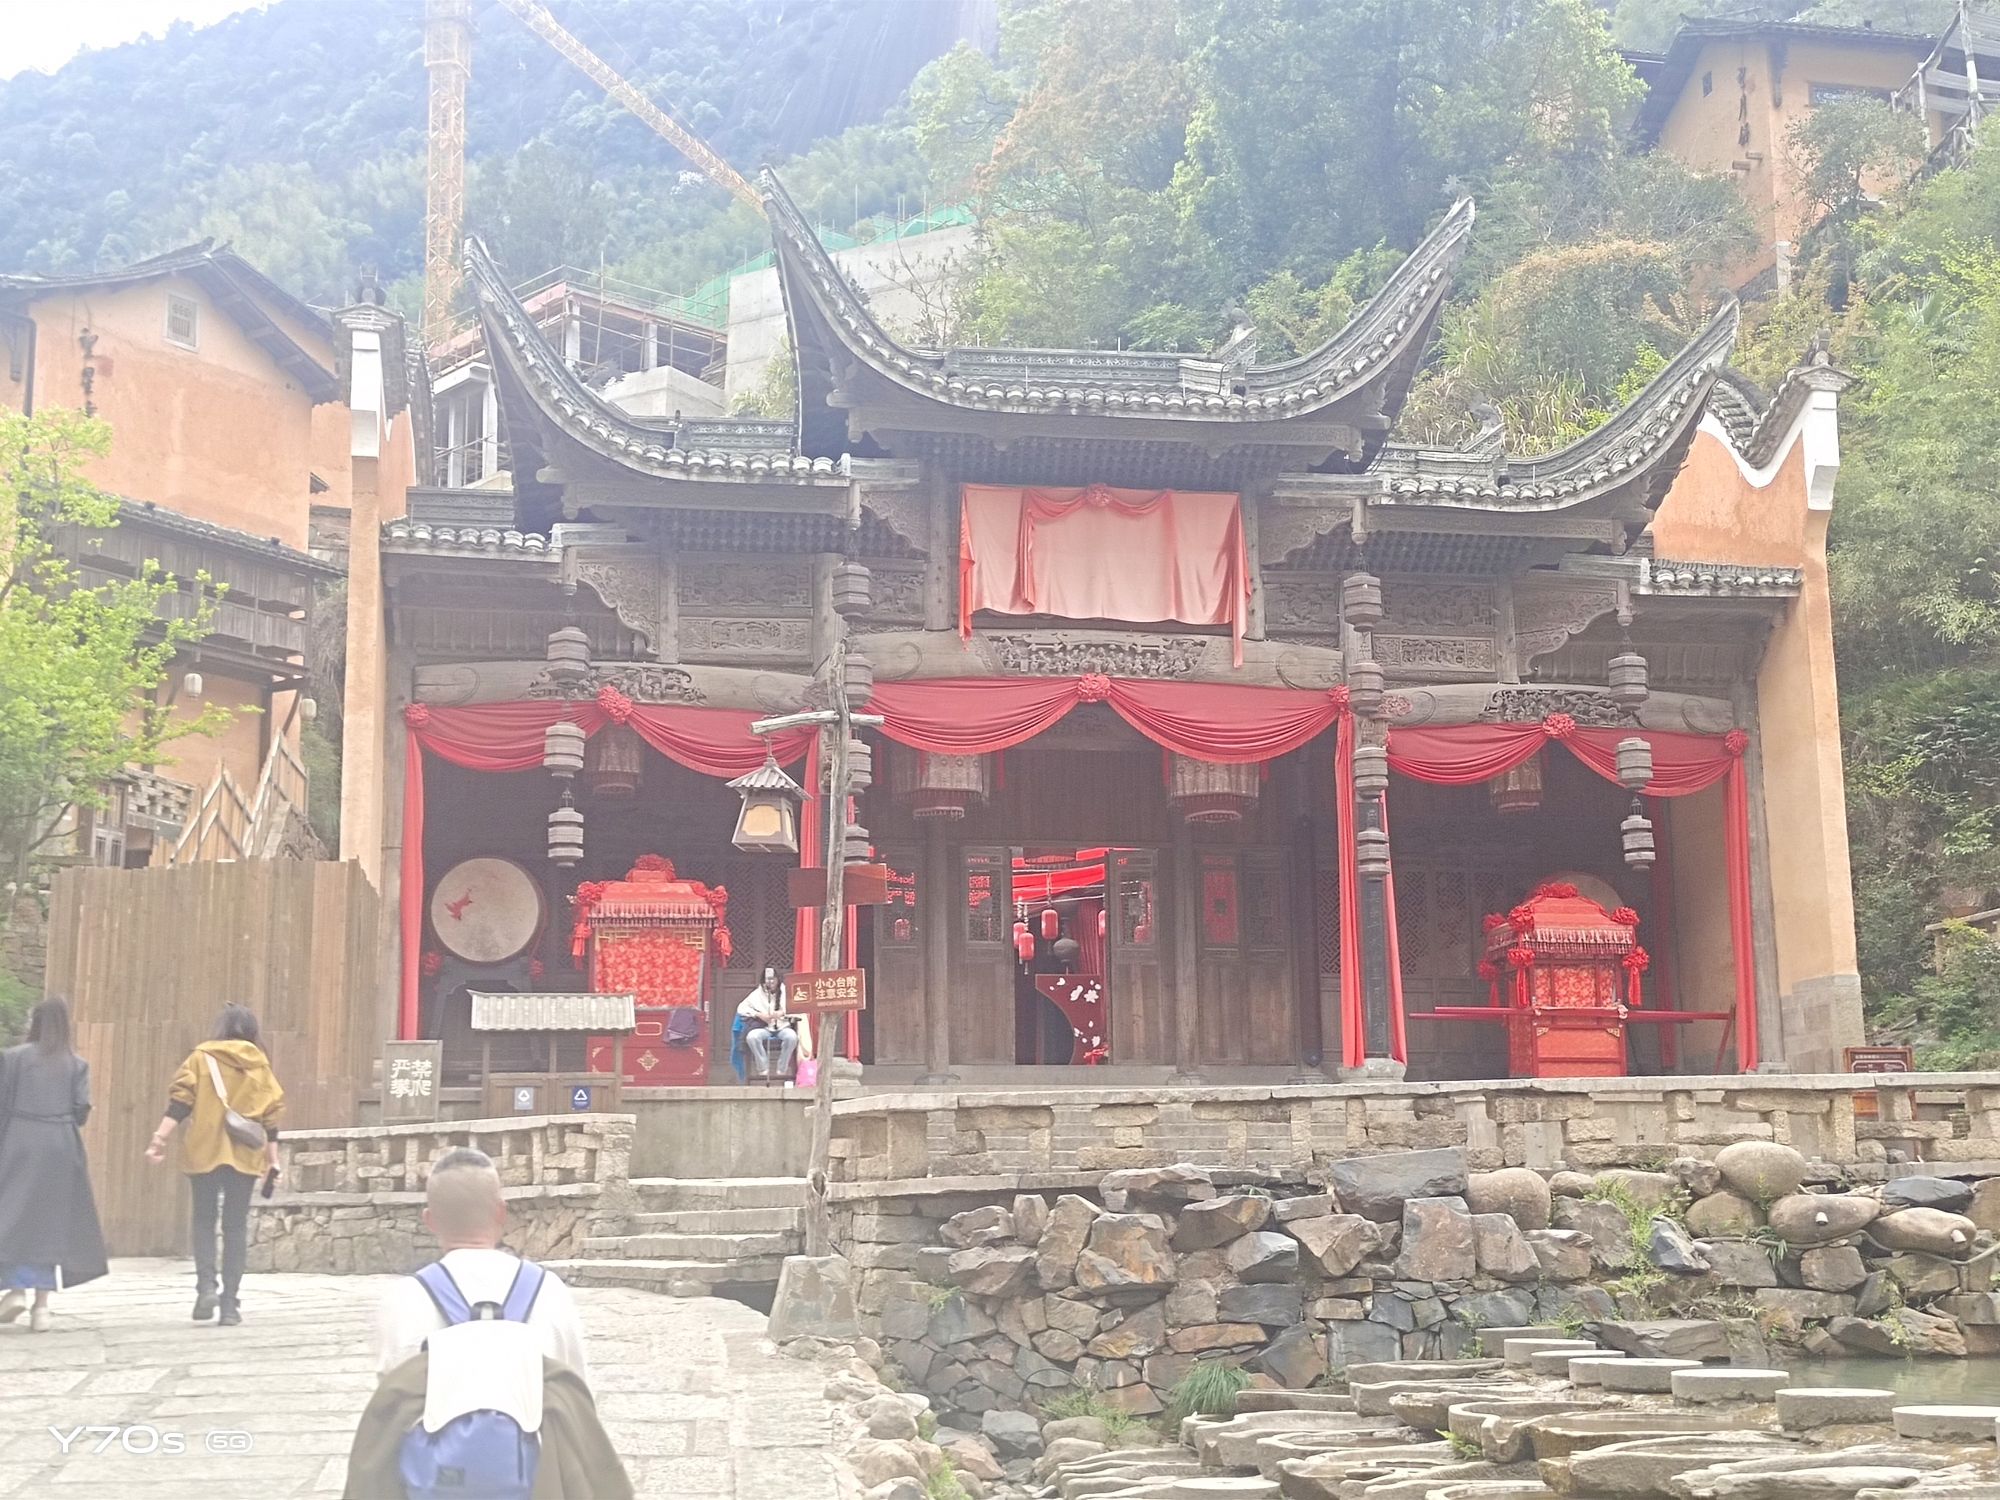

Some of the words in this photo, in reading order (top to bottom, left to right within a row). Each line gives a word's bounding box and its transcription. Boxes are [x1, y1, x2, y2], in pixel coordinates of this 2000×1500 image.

[815, 976, 857, 989] 小心台阶
[816, 987, 858, 1000] 注意安全
[390, 1059, 432, 1080] 严禁
[390, 1078, 432, 1098] 攀爬
